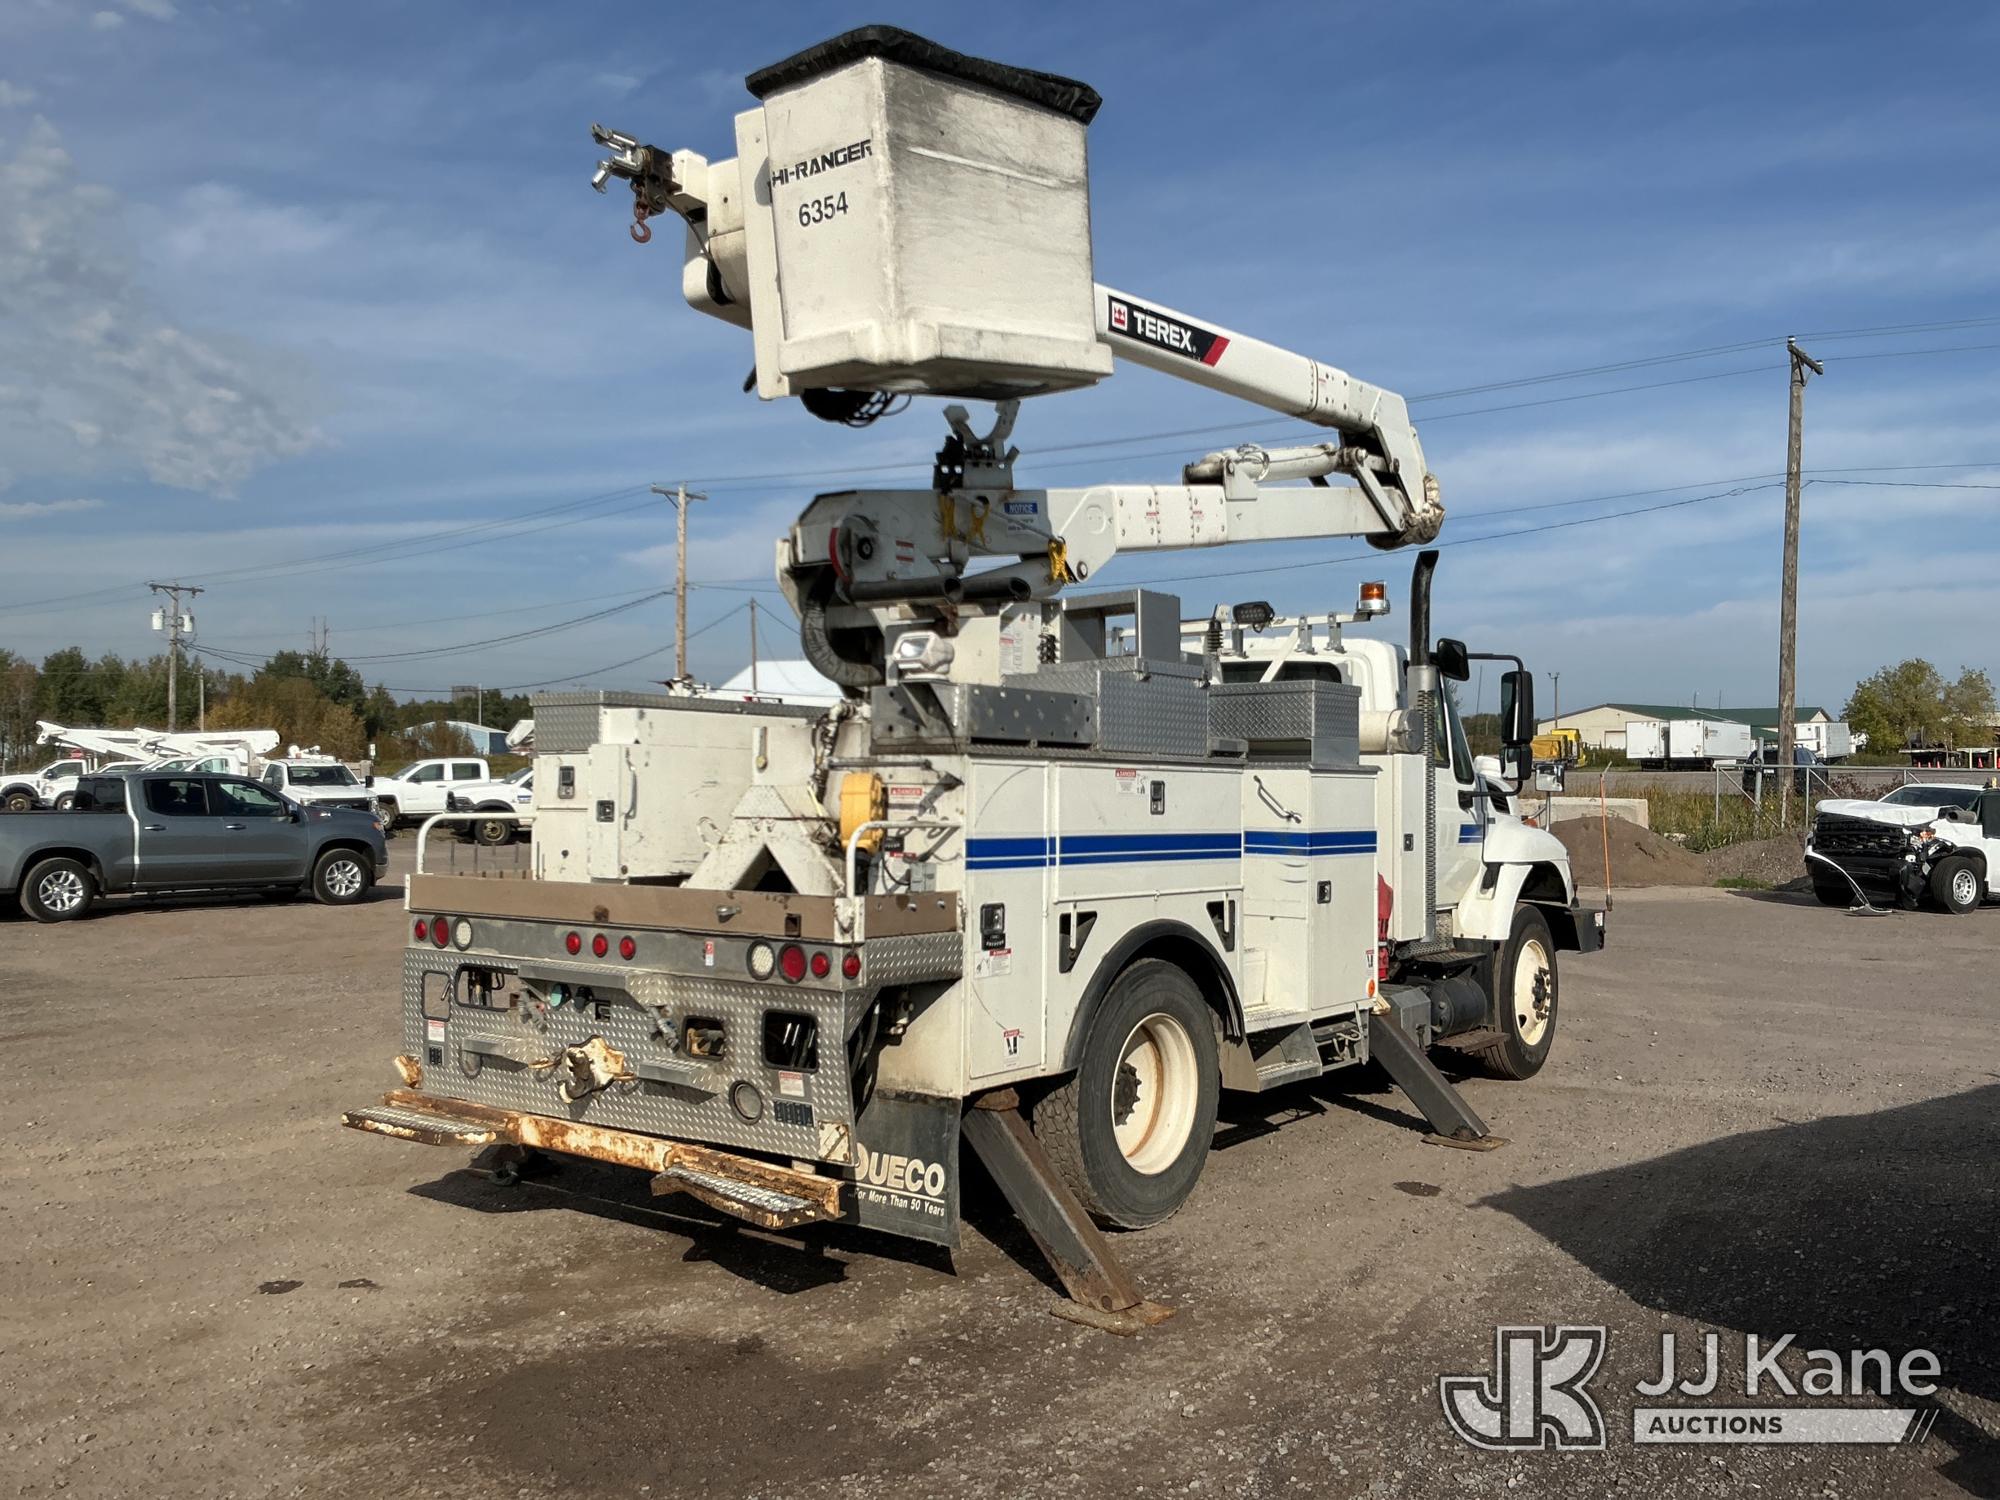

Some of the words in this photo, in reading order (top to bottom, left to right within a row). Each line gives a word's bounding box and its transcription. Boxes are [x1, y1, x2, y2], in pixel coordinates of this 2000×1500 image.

[771, 138, 873, 187] HI-RANGER
[798, 191, 848, 227] 6354
[1133, 310, 1192, 353] TEREX
[1009, 503, 1033, 514] NOTICE
[868, 1190, 887, 1204] More
[890, 1194, 908, 1209] Than
[910, 1198, 921, 1211] 50
[924, 1201, 945, 1217] Years
